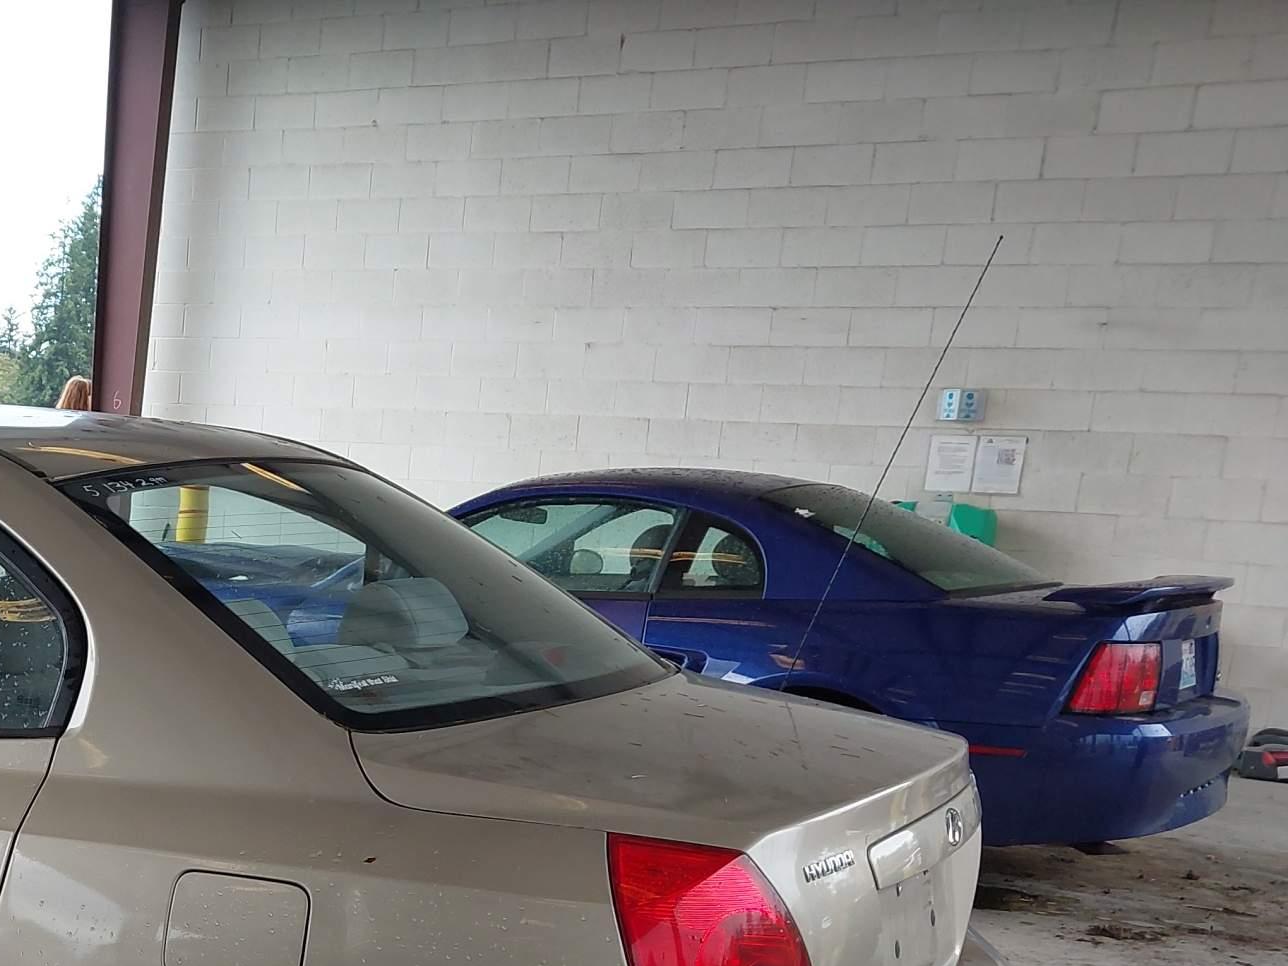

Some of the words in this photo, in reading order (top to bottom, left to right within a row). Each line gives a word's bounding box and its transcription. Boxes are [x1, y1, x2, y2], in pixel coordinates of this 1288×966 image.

[113, 390, 122, 410] 6
[82, 484, 100, 497] 5
[802, 849, 856, 883] HYUNDAI
